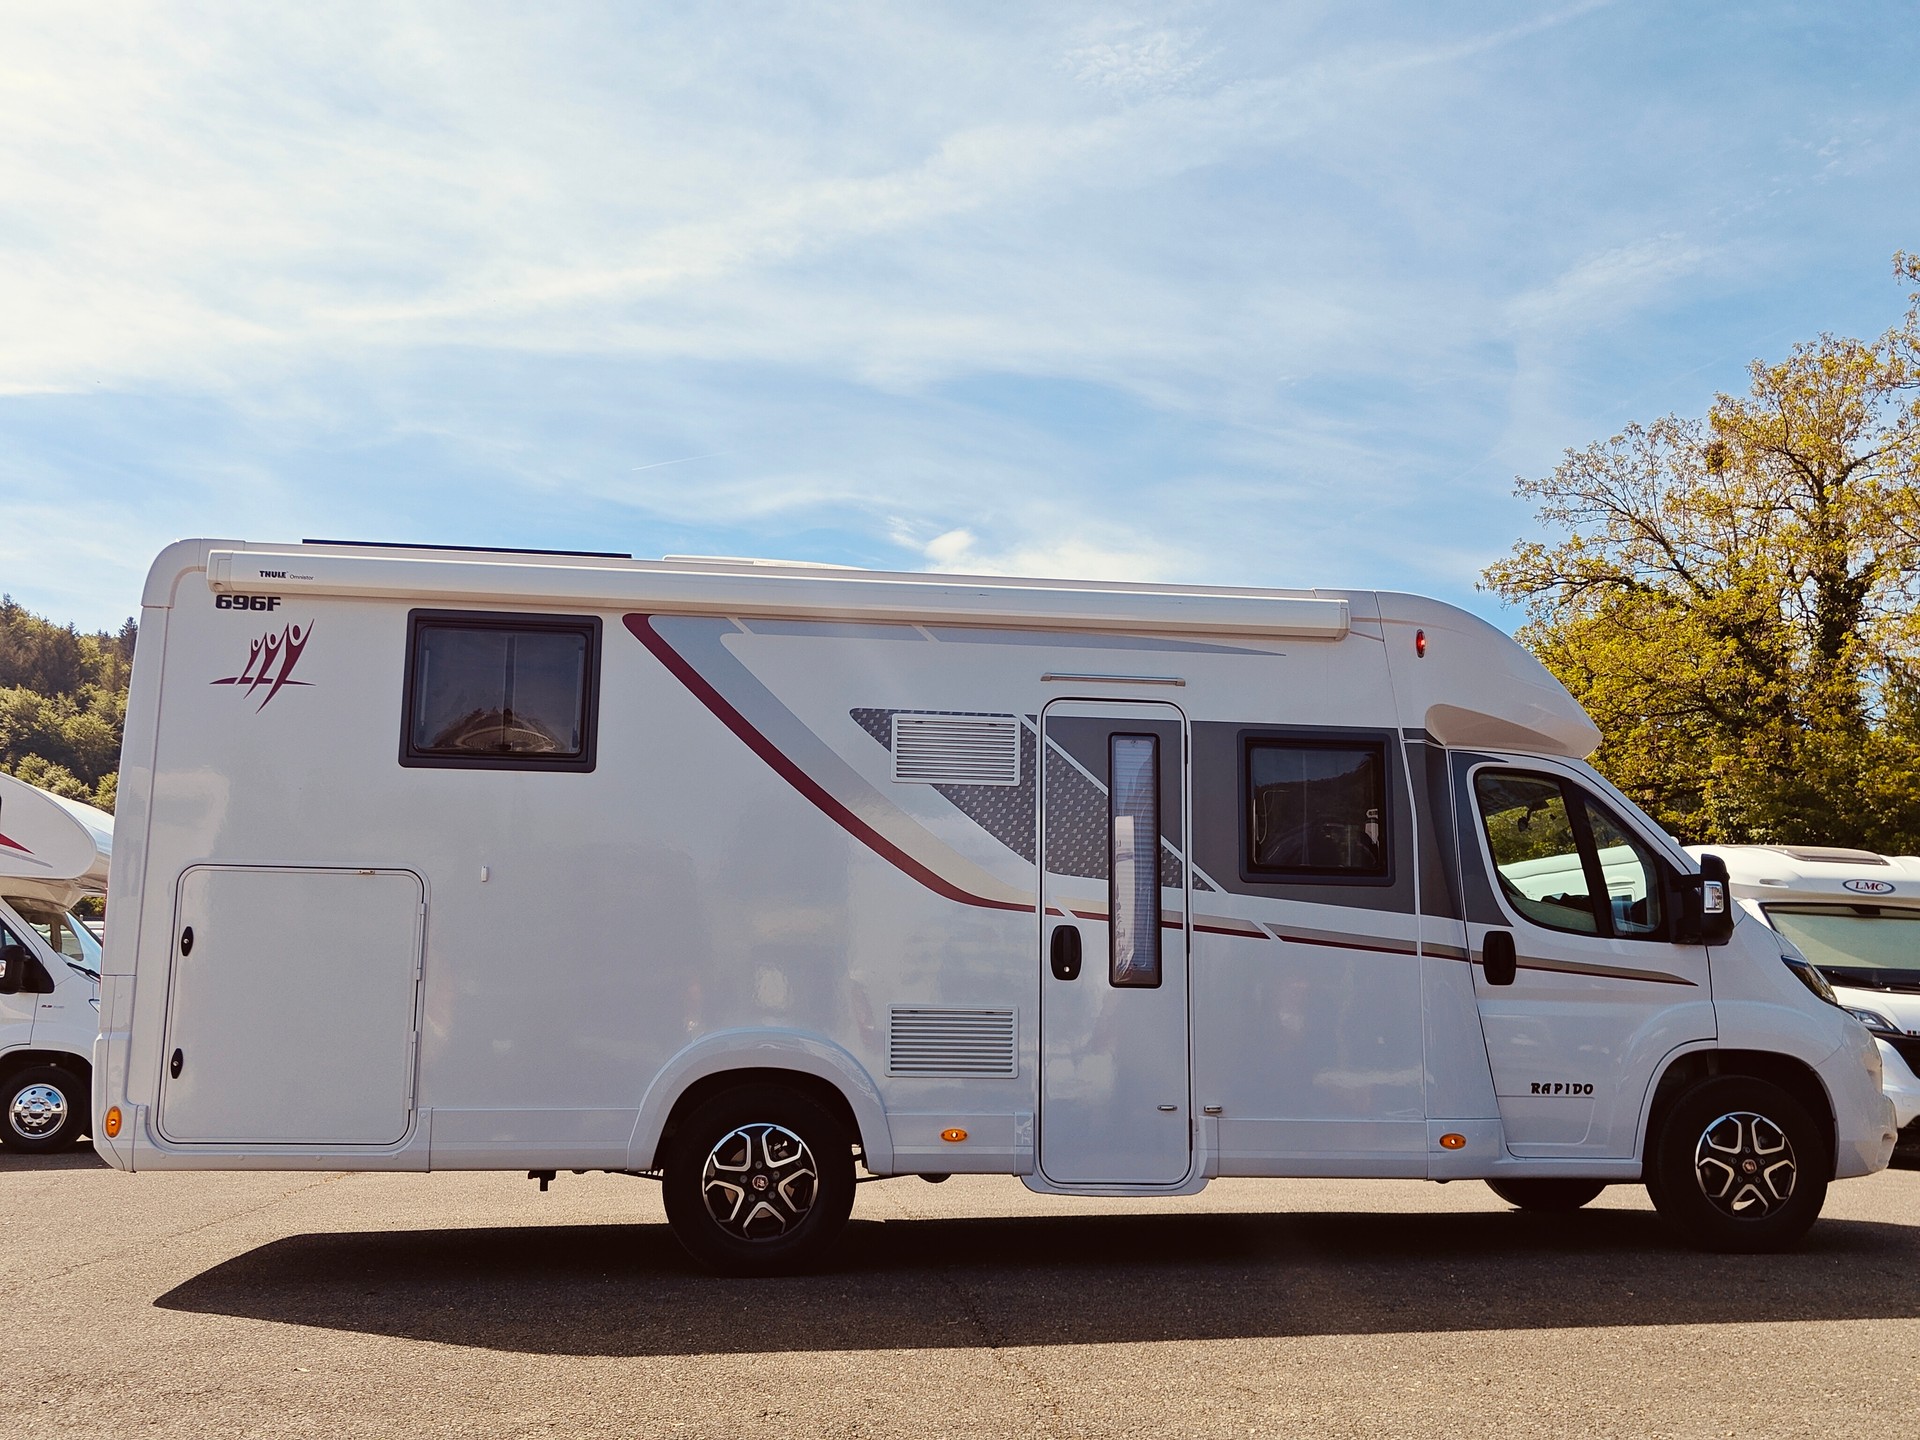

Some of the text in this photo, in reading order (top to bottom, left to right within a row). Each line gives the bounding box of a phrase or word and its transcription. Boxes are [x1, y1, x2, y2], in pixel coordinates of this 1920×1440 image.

[259, 570, 286, 578] THULE
[215, 594, 281, 611] 696F
[1855, 881, 1884, 891] LMC
[1531, 1082, 1594, 1095] RAPIDO
